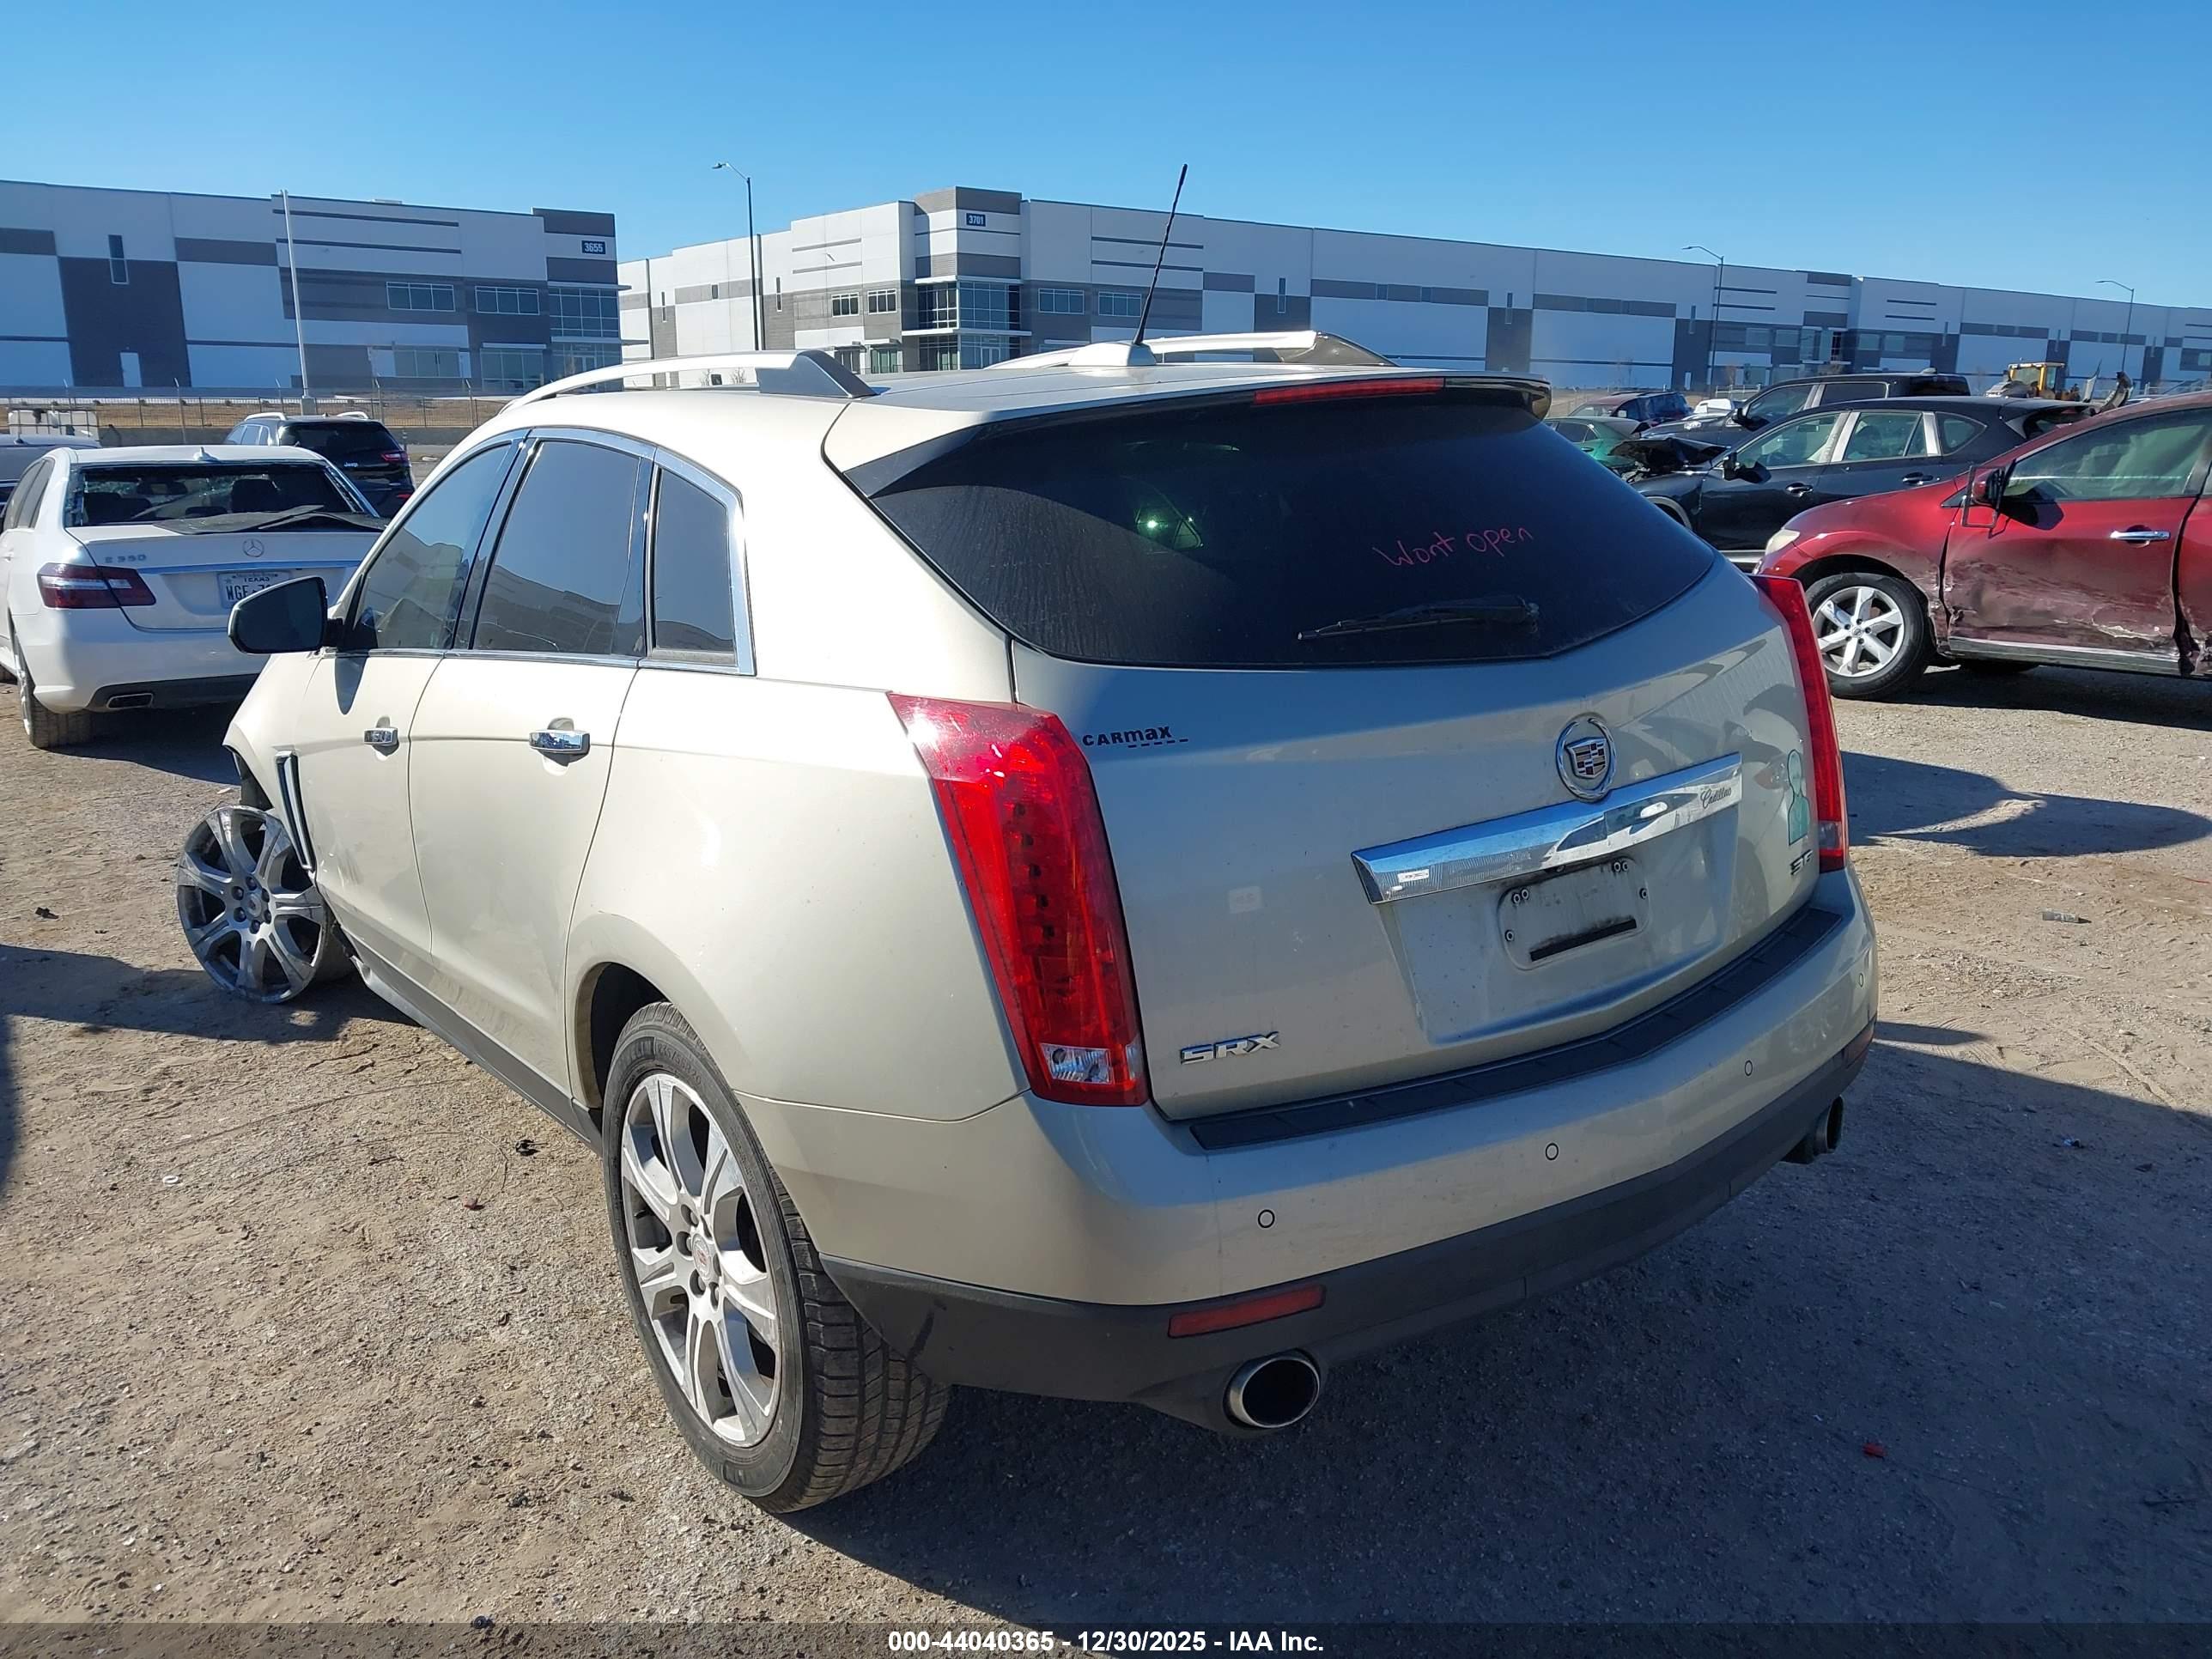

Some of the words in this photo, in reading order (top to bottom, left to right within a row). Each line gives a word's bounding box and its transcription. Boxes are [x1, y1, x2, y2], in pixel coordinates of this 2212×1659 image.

[969, 215, 984, 225] 3701
[584, 242, 604, 252] 3655
[1371, 532, 1455, 566] Wont
[1180, 1030, 1279, 1065] SRX
